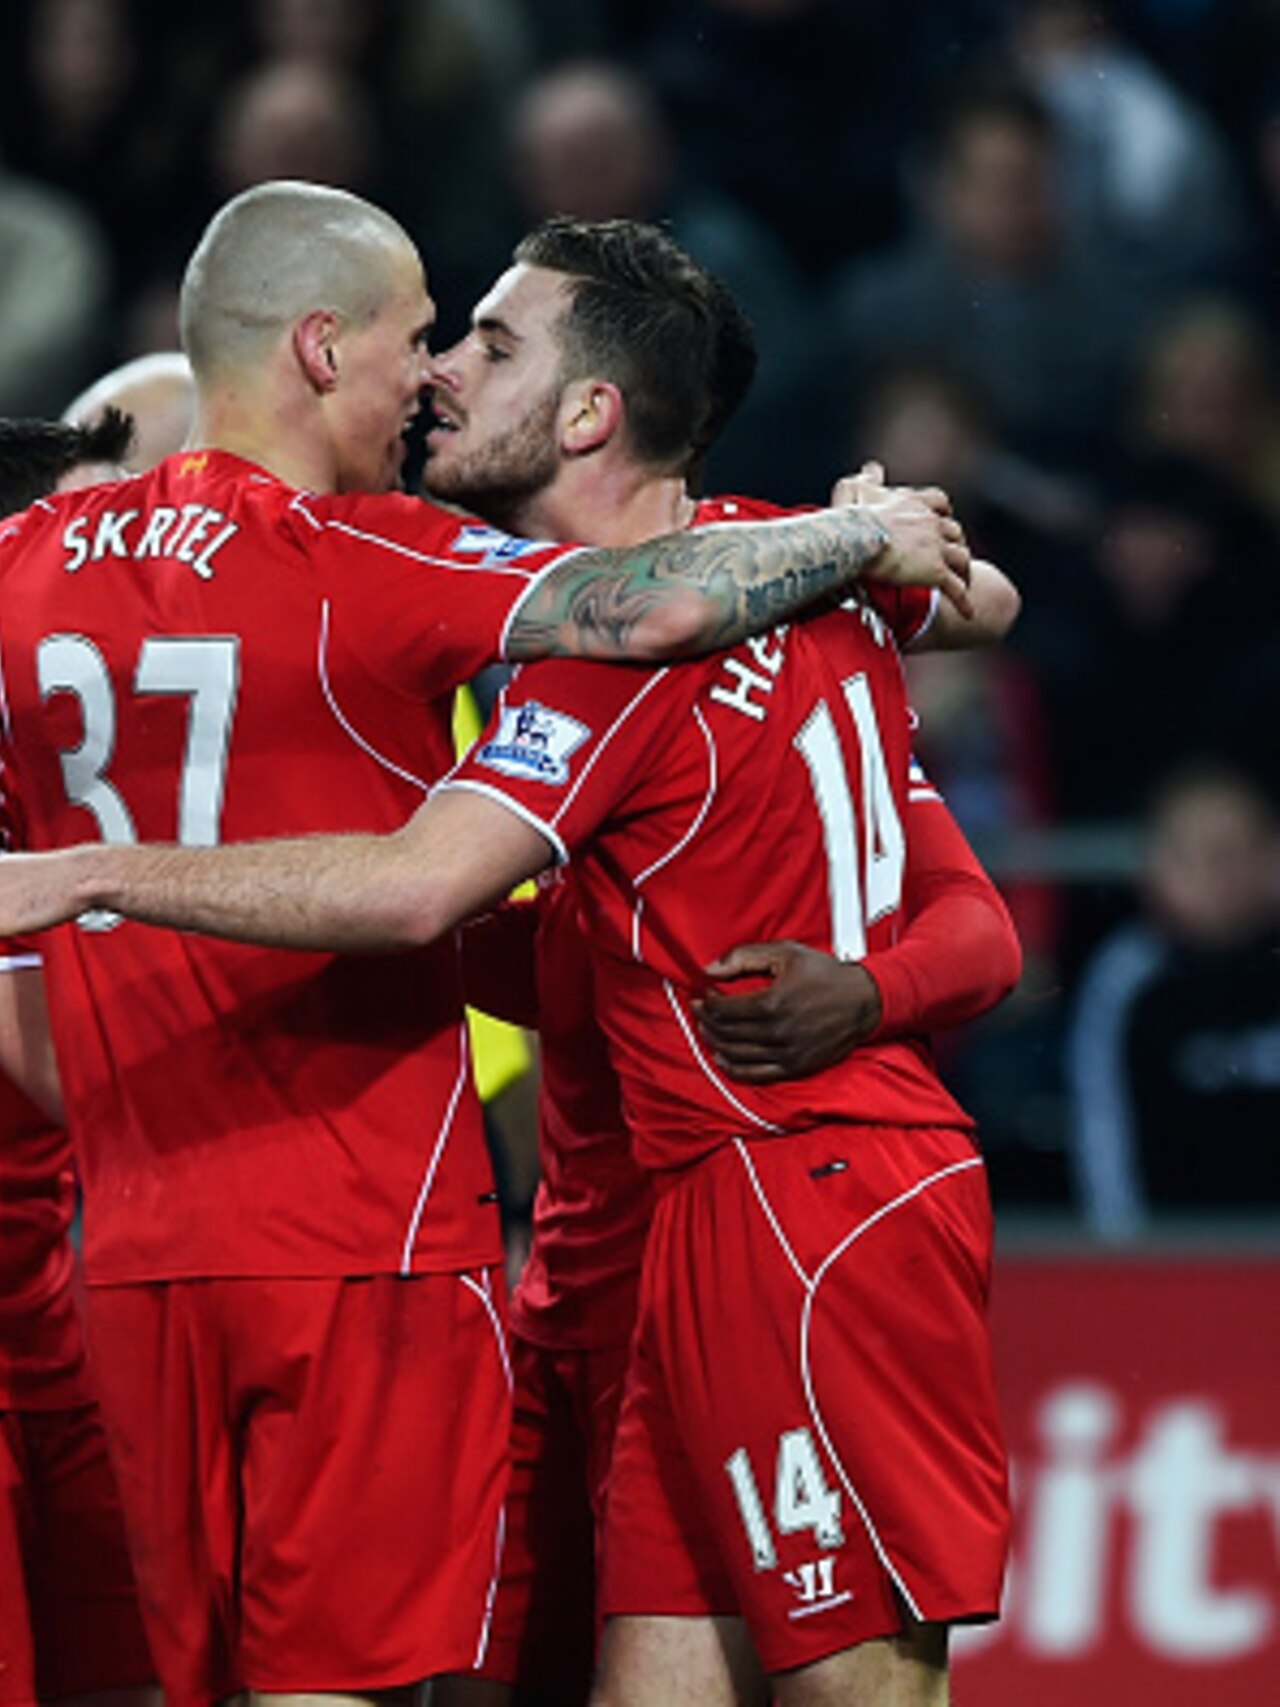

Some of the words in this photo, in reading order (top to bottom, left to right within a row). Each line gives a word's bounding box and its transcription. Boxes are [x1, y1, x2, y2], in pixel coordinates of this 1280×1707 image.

[61, 503, 239, 579] SKRTEL
[35, 633, 242, 932] 37
[792, 671, 907, 963] 14
[724, 1426, 846, 1573] 14
[952, 1378, 1280, 1656] it
